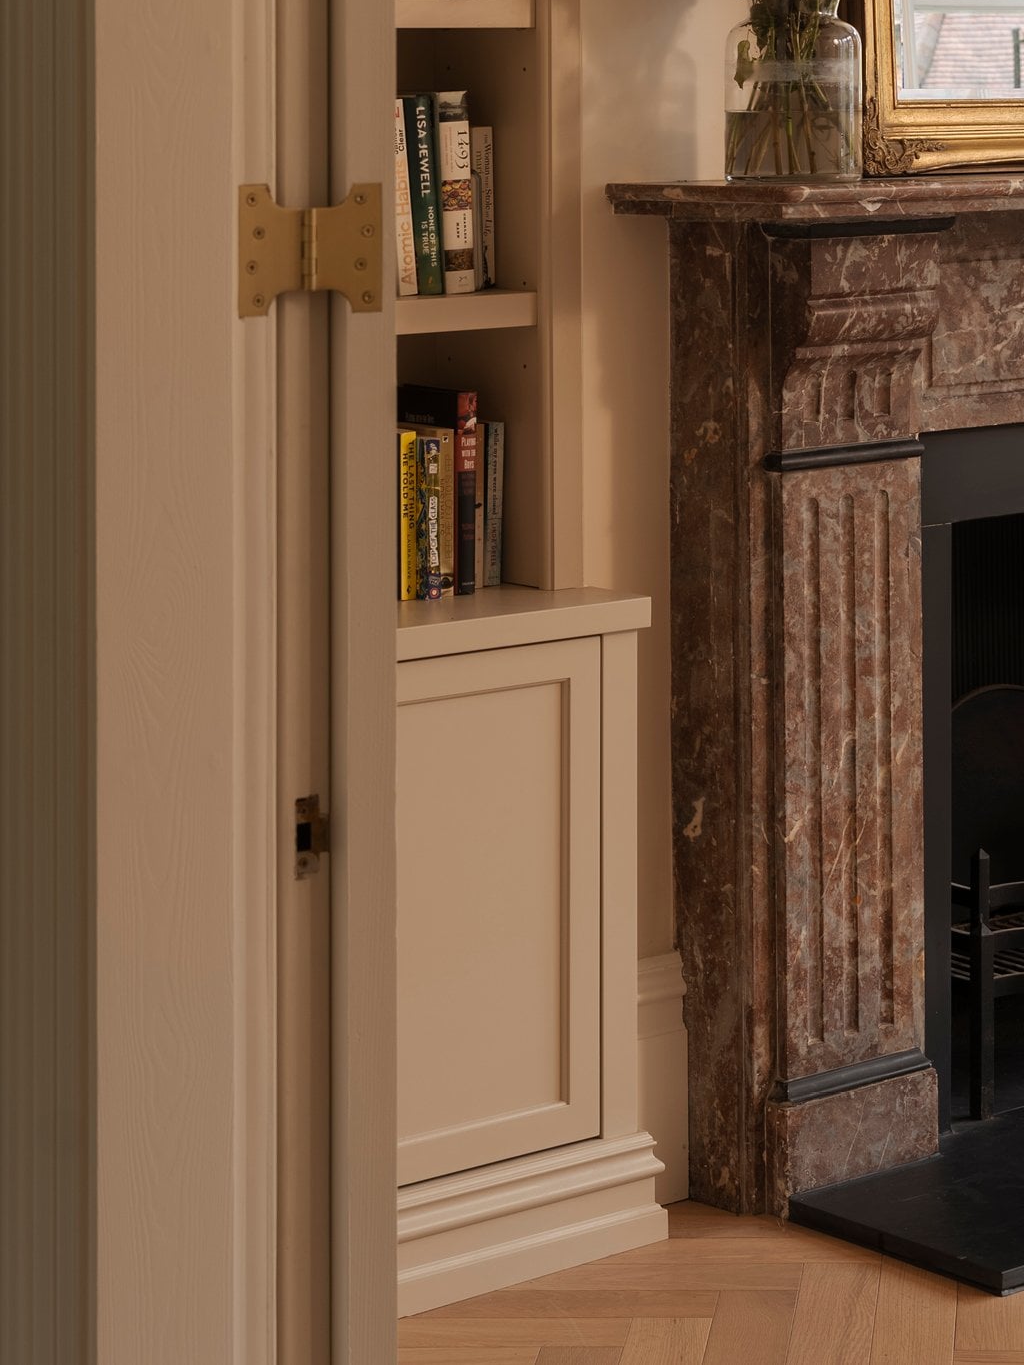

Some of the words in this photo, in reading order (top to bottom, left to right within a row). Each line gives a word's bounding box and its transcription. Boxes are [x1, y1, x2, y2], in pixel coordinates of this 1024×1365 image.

[415, 106, 427, 139] LISA
[455, 130, 469, 170] 1493
[483, 143, 492, 176] Woman
[418, 143, 431, 198] JEWELL
[395, 161, 409, 216] Habits
[484, 189, 492, 211] Stole
[422, 220, 429, 230] IS
[427, 206, 435, 232] NONE
[484, 219, 493, 237] Life
[422, 232, 430, 255] TRUE
[429, 233, 436, 244] OF
[400, 221, 416, 286] Atomic
[402, 453, 409, 467] HE
[402, 504, 408, 518] ME
[429, 496, 438, 519] CLASS
[490, 522, 498, 544] LINDA
